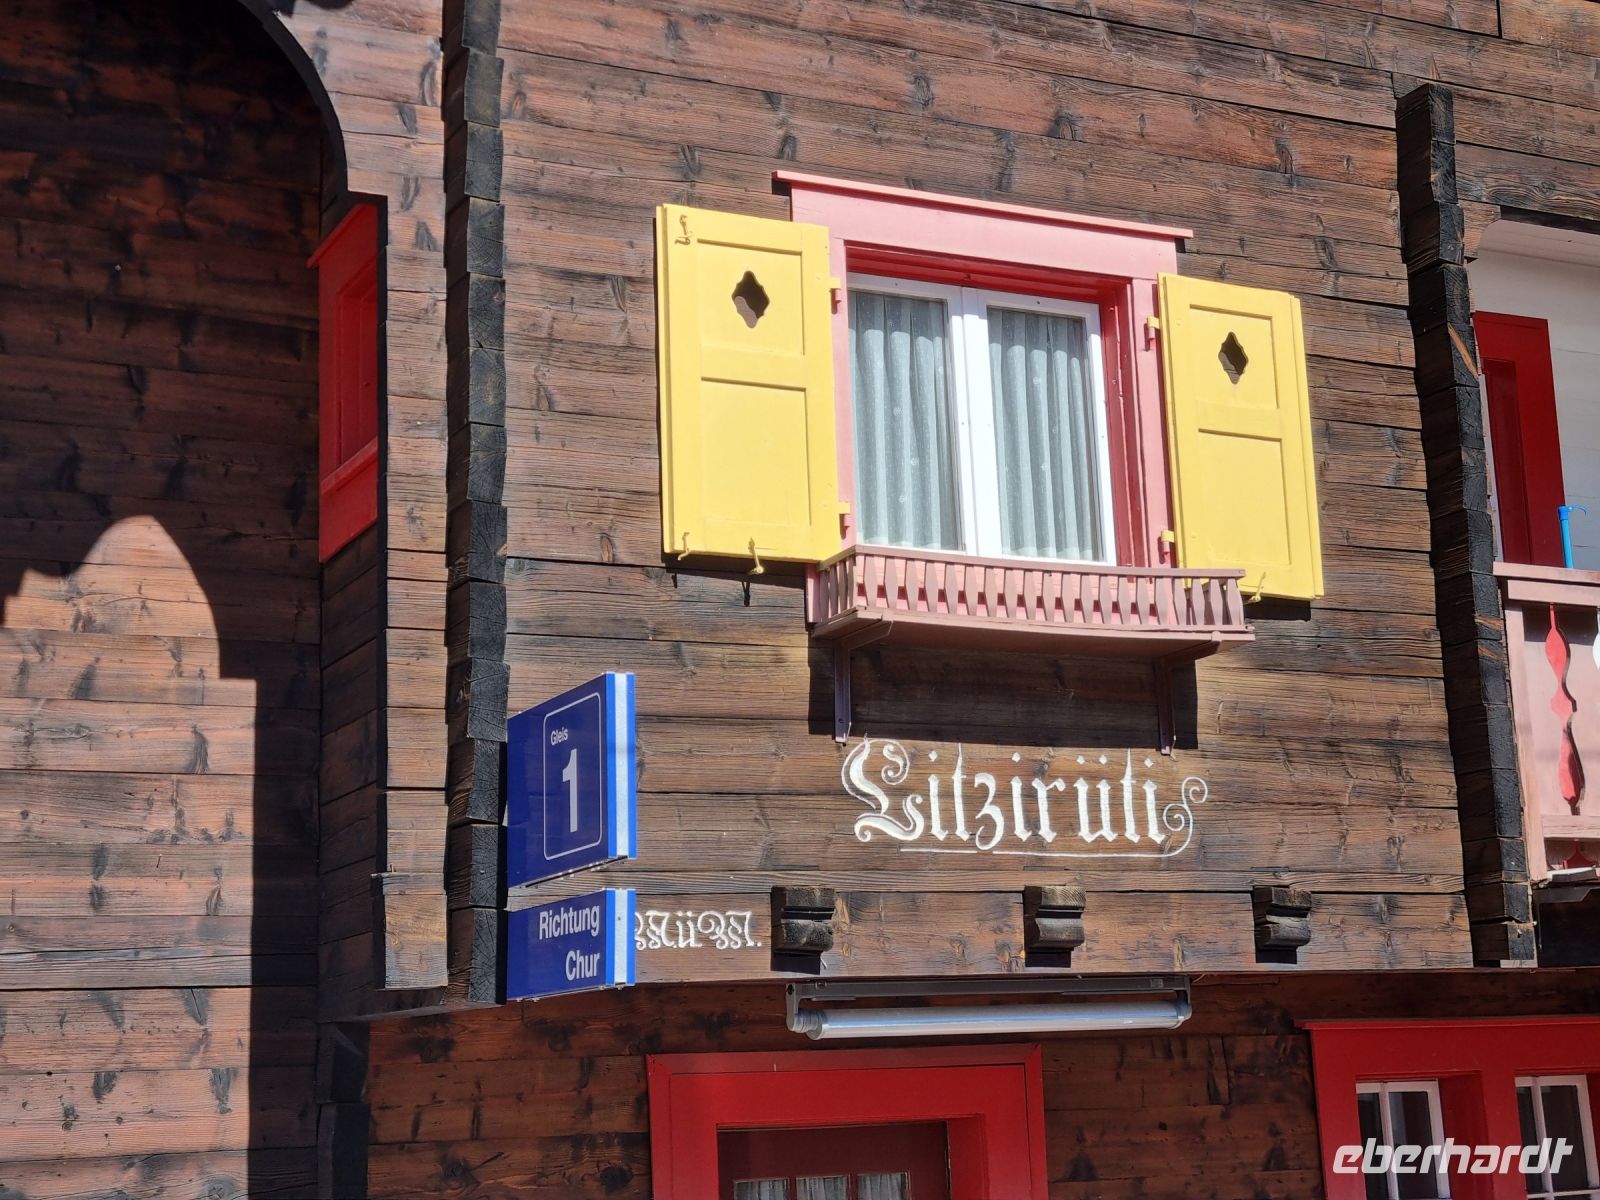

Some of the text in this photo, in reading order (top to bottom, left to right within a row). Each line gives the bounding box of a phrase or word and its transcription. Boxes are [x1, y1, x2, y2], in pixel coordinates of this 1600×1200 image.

[551, 727, 569, 746] Gleis
[562, 748, 578, 833] 1
[841, 734, 1175, 852] Litzirüti
[539, 904, 600, 940] Richtung
[565, 951, 600, 981] Chur
